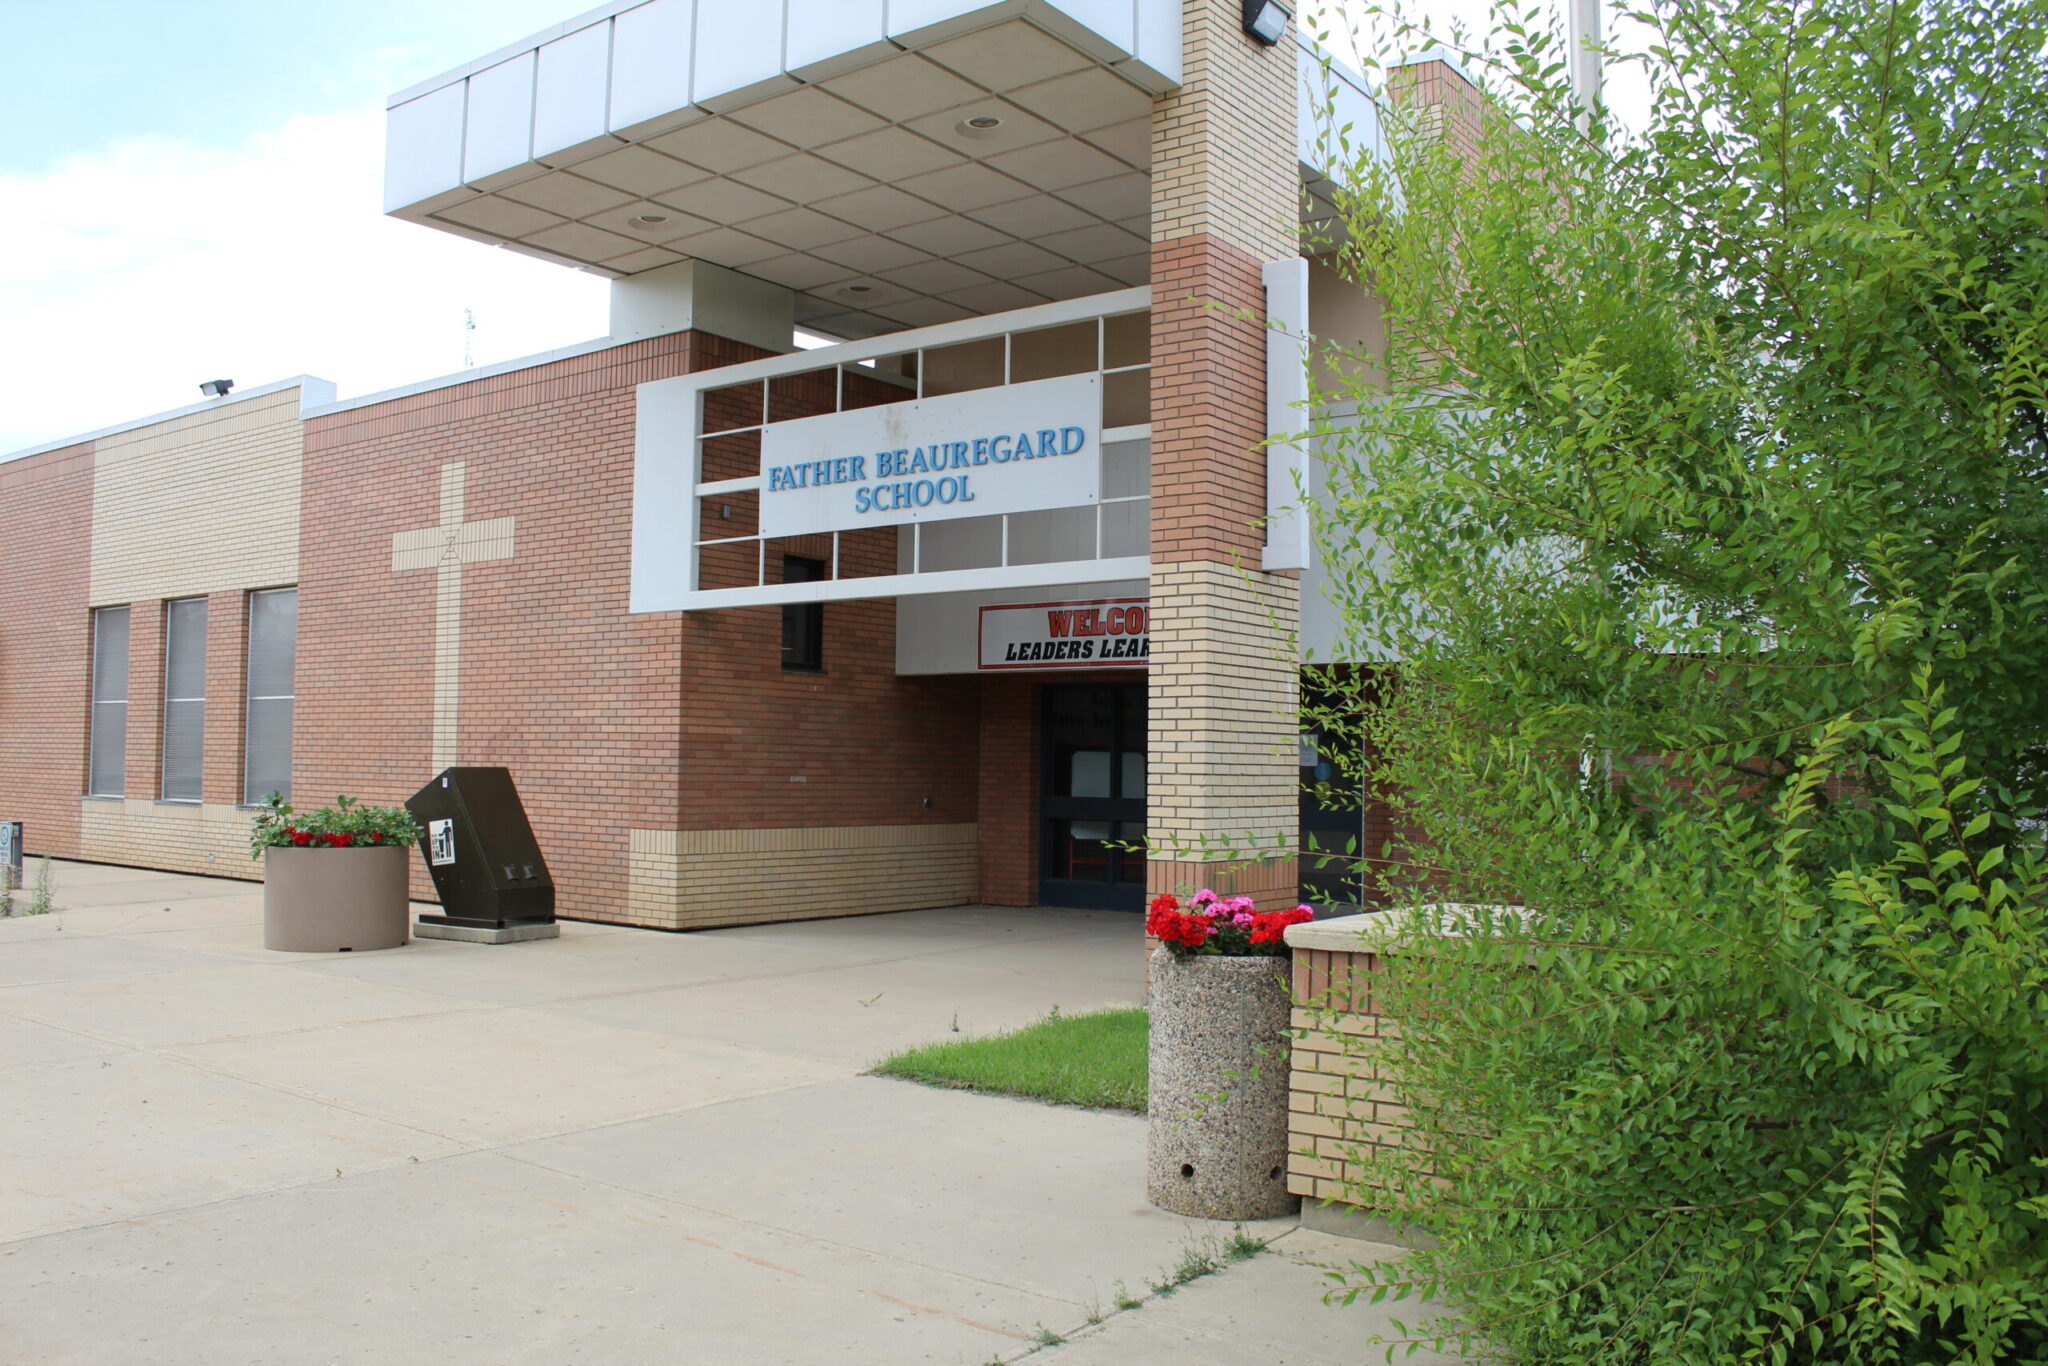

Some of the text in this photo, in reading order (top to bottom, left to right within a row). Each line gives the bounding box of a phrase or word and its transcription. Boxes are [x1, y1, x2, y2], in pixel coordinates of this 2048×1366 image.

[767, 425, 1085, 492] FATHER BEAUREGARD
[855, 474, 975, 514] SCHOOL
[1048, 606, 1150, 638] WELCO
[1005, 640, 1094, 661] LEADERS
